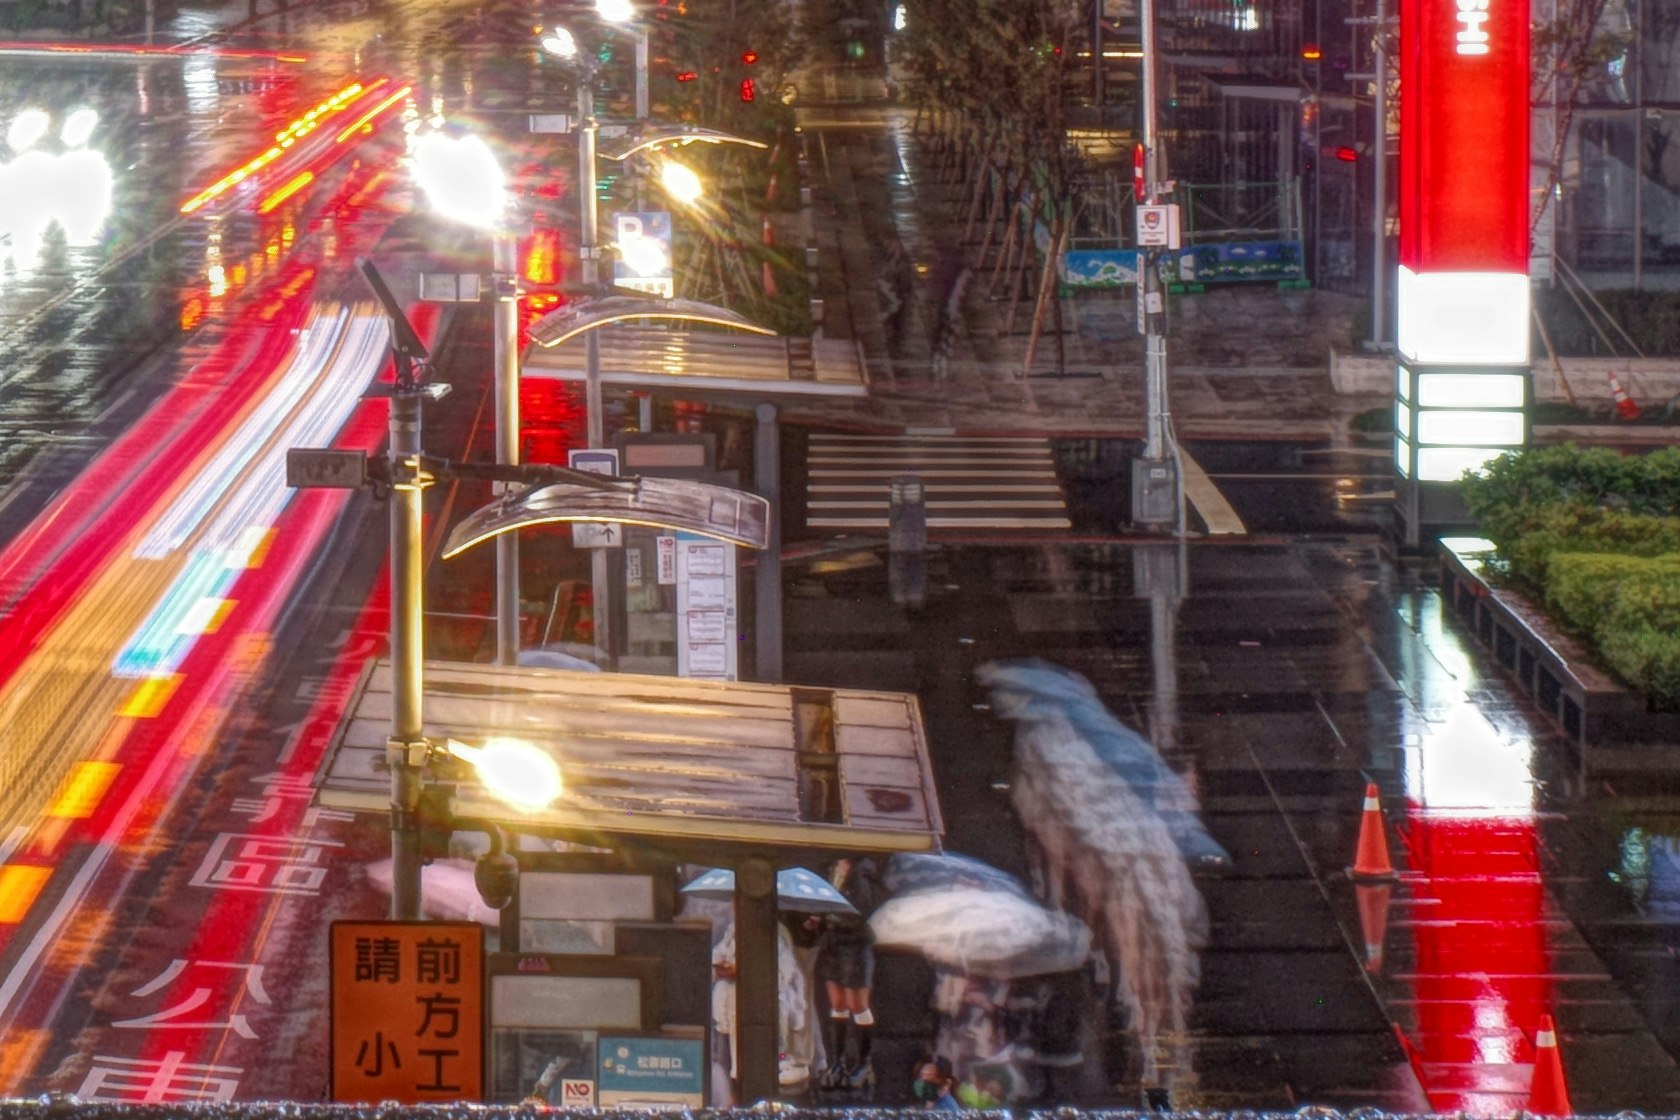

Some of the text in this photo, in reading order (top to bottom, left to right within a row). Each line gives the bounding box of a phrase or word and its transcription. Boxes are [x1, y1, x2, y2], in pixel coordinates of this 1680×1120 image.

[355, 937, 401, 1077] 請小
[415, 937, 461, 1092] 前方工
